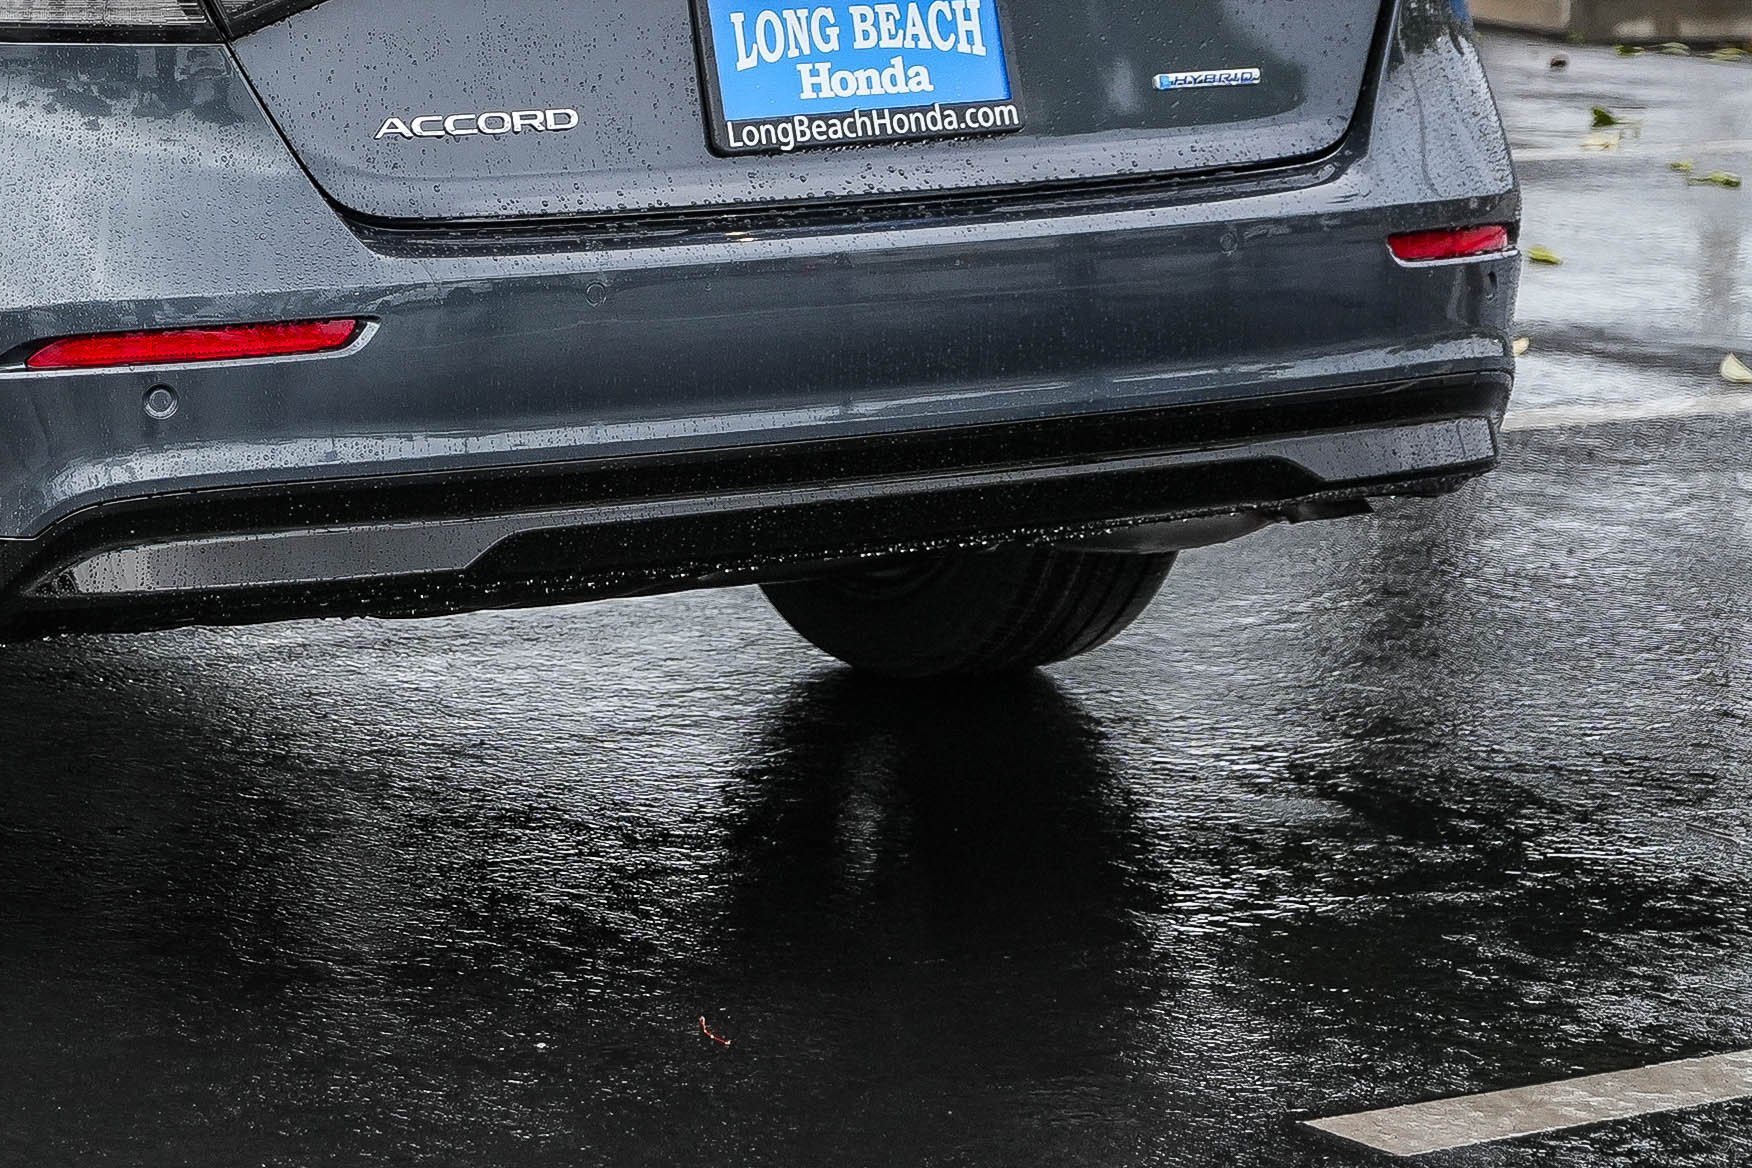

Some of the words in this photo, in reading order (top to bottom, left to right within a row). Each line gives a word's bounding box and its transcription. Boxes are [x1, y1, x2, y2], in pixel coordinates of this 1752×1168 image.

[729, 6, 840, 72] LONG
[796, 55, 934, 101] Honda
[1172, 71, 1256, 86] HYBRID
[373, 108, 580, 140] ACCORD
[727, 103, 1020, 151] LongBeachHonda.com
